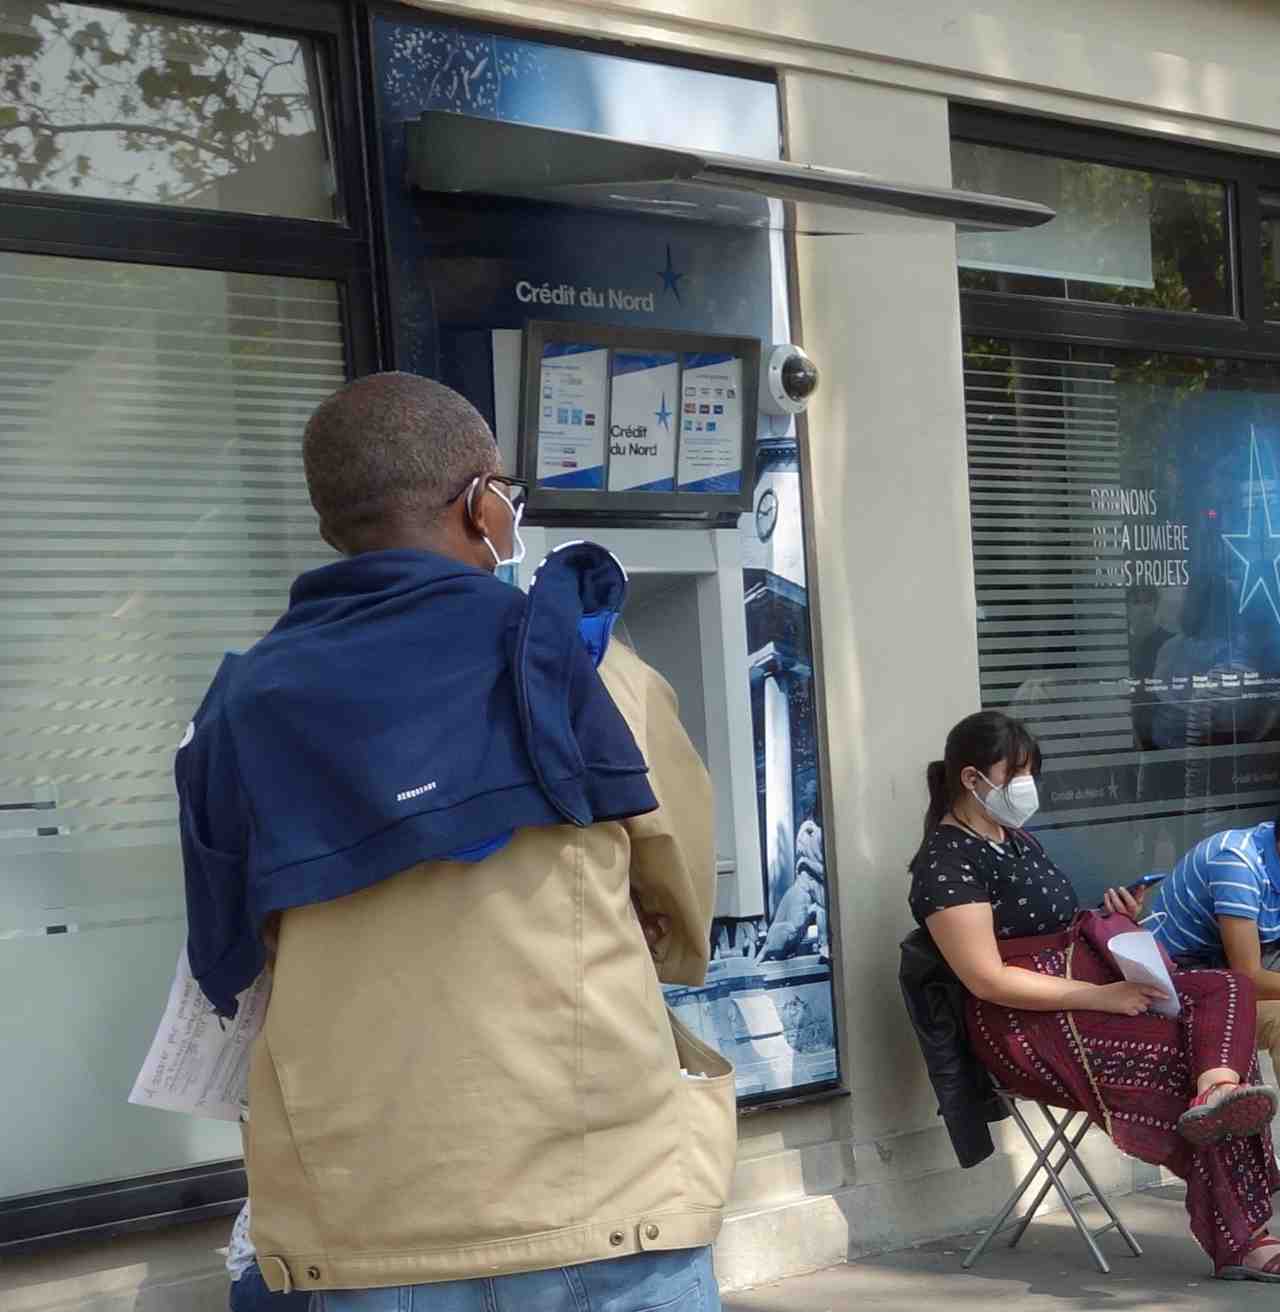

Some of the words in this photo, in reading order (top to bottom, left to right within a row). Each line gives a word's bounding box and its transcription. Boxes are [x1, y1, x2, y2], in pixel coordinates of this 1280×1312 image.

[515, 281, 575, 305] Crédit
[580, 287, 604, 308] du
[609, 288, 655, 312] Nord
[610, 425, 647, 439] Crédit
[609, 444, 626, 456] du
[629, 444, 657, 456] Nord
[1134, 520, 1190, 551] LUMIÈRE
[1136, 560, 1190, 586] PROJETS
